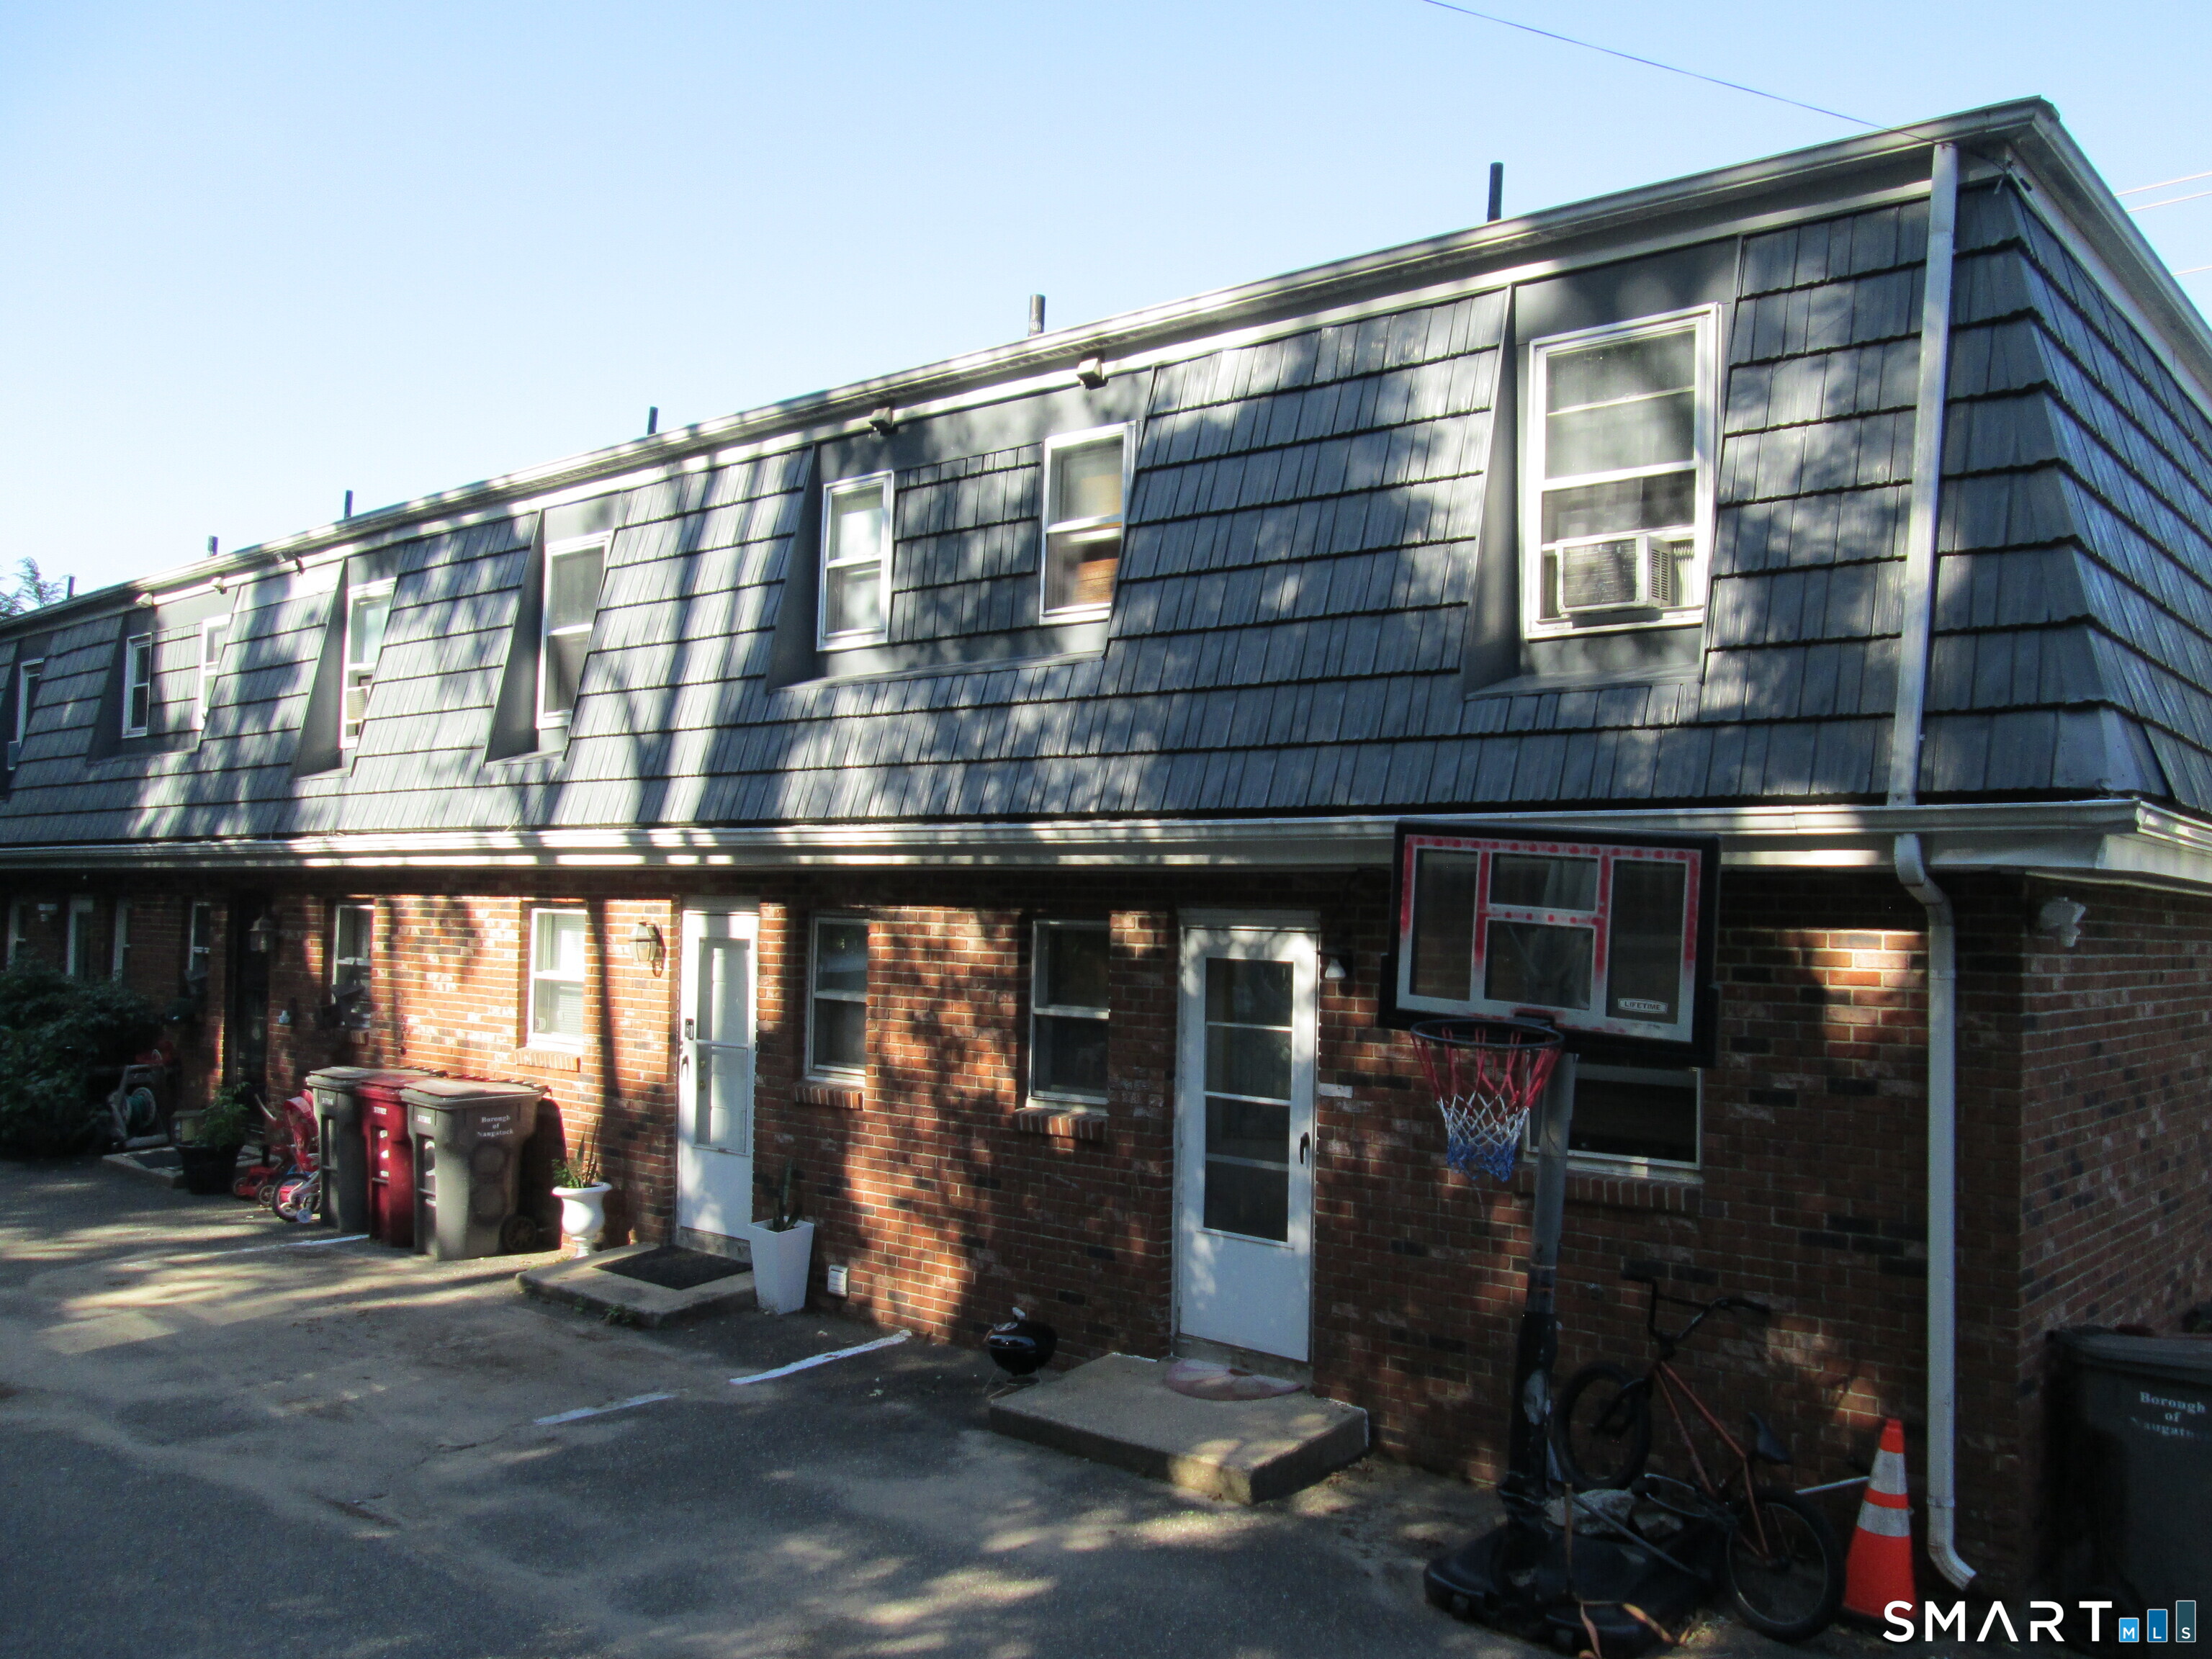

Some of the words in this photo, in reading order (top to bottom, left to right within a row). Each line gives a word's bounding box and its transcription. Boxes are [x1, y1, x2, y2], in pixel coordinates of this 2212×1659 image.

[1624, 1001, 1662, 1010] LIFETIME
[481, 1115, 511, 1123] Borough
[2139, 1391, 2206, 1414] Borough
[2164, 1411, 2182, 1422] of
